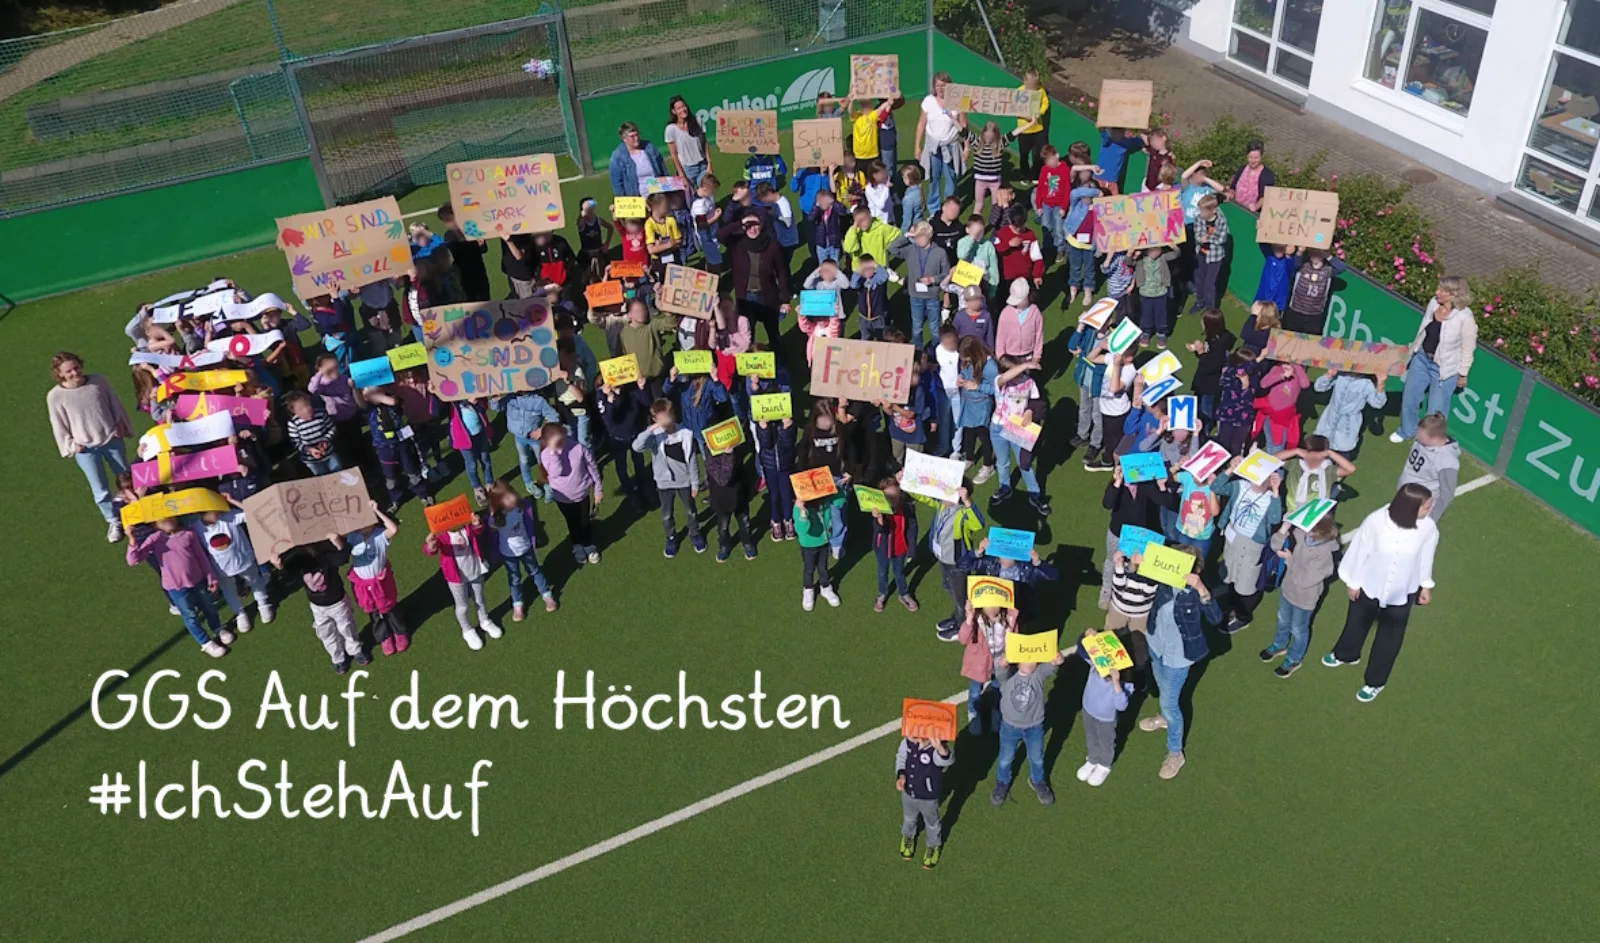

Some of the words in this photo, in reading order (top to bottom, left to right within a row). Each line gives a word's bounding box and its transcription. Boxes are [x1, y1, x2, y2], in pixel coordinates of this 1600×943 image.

[464, 163, 553, 185] ZUSAMMEN
[525, 180, 552, 195] WIR
[301, 218, 336, 239] WIR
[345, 208, 389, 232] SIND
[482, 205, 526, 222] STARK
[1278, 221, 1308, 237] LEN
[669, 266, 714, 291] FREI
[662, 288, 714, 313] LEBEN
[398, 350, 421, 361] bunt
[474, 345, 534, 368] SIND
[745, 359, 768, 370] bunt
[461, 367, 521, 395] BUNT
[607, 365, 636, 377] anders
[761, 402, 785, 413] bunt
[713, 428, 738, 444] bunt
[250, 486, 361, 541] Fieden
[430, 504, 467, 525] Vielfalt
[1153, 555, 1181, 575] bunt
[1019, 643, 1048, 654] bunt
[1095, 636, 1118, 669] anders
